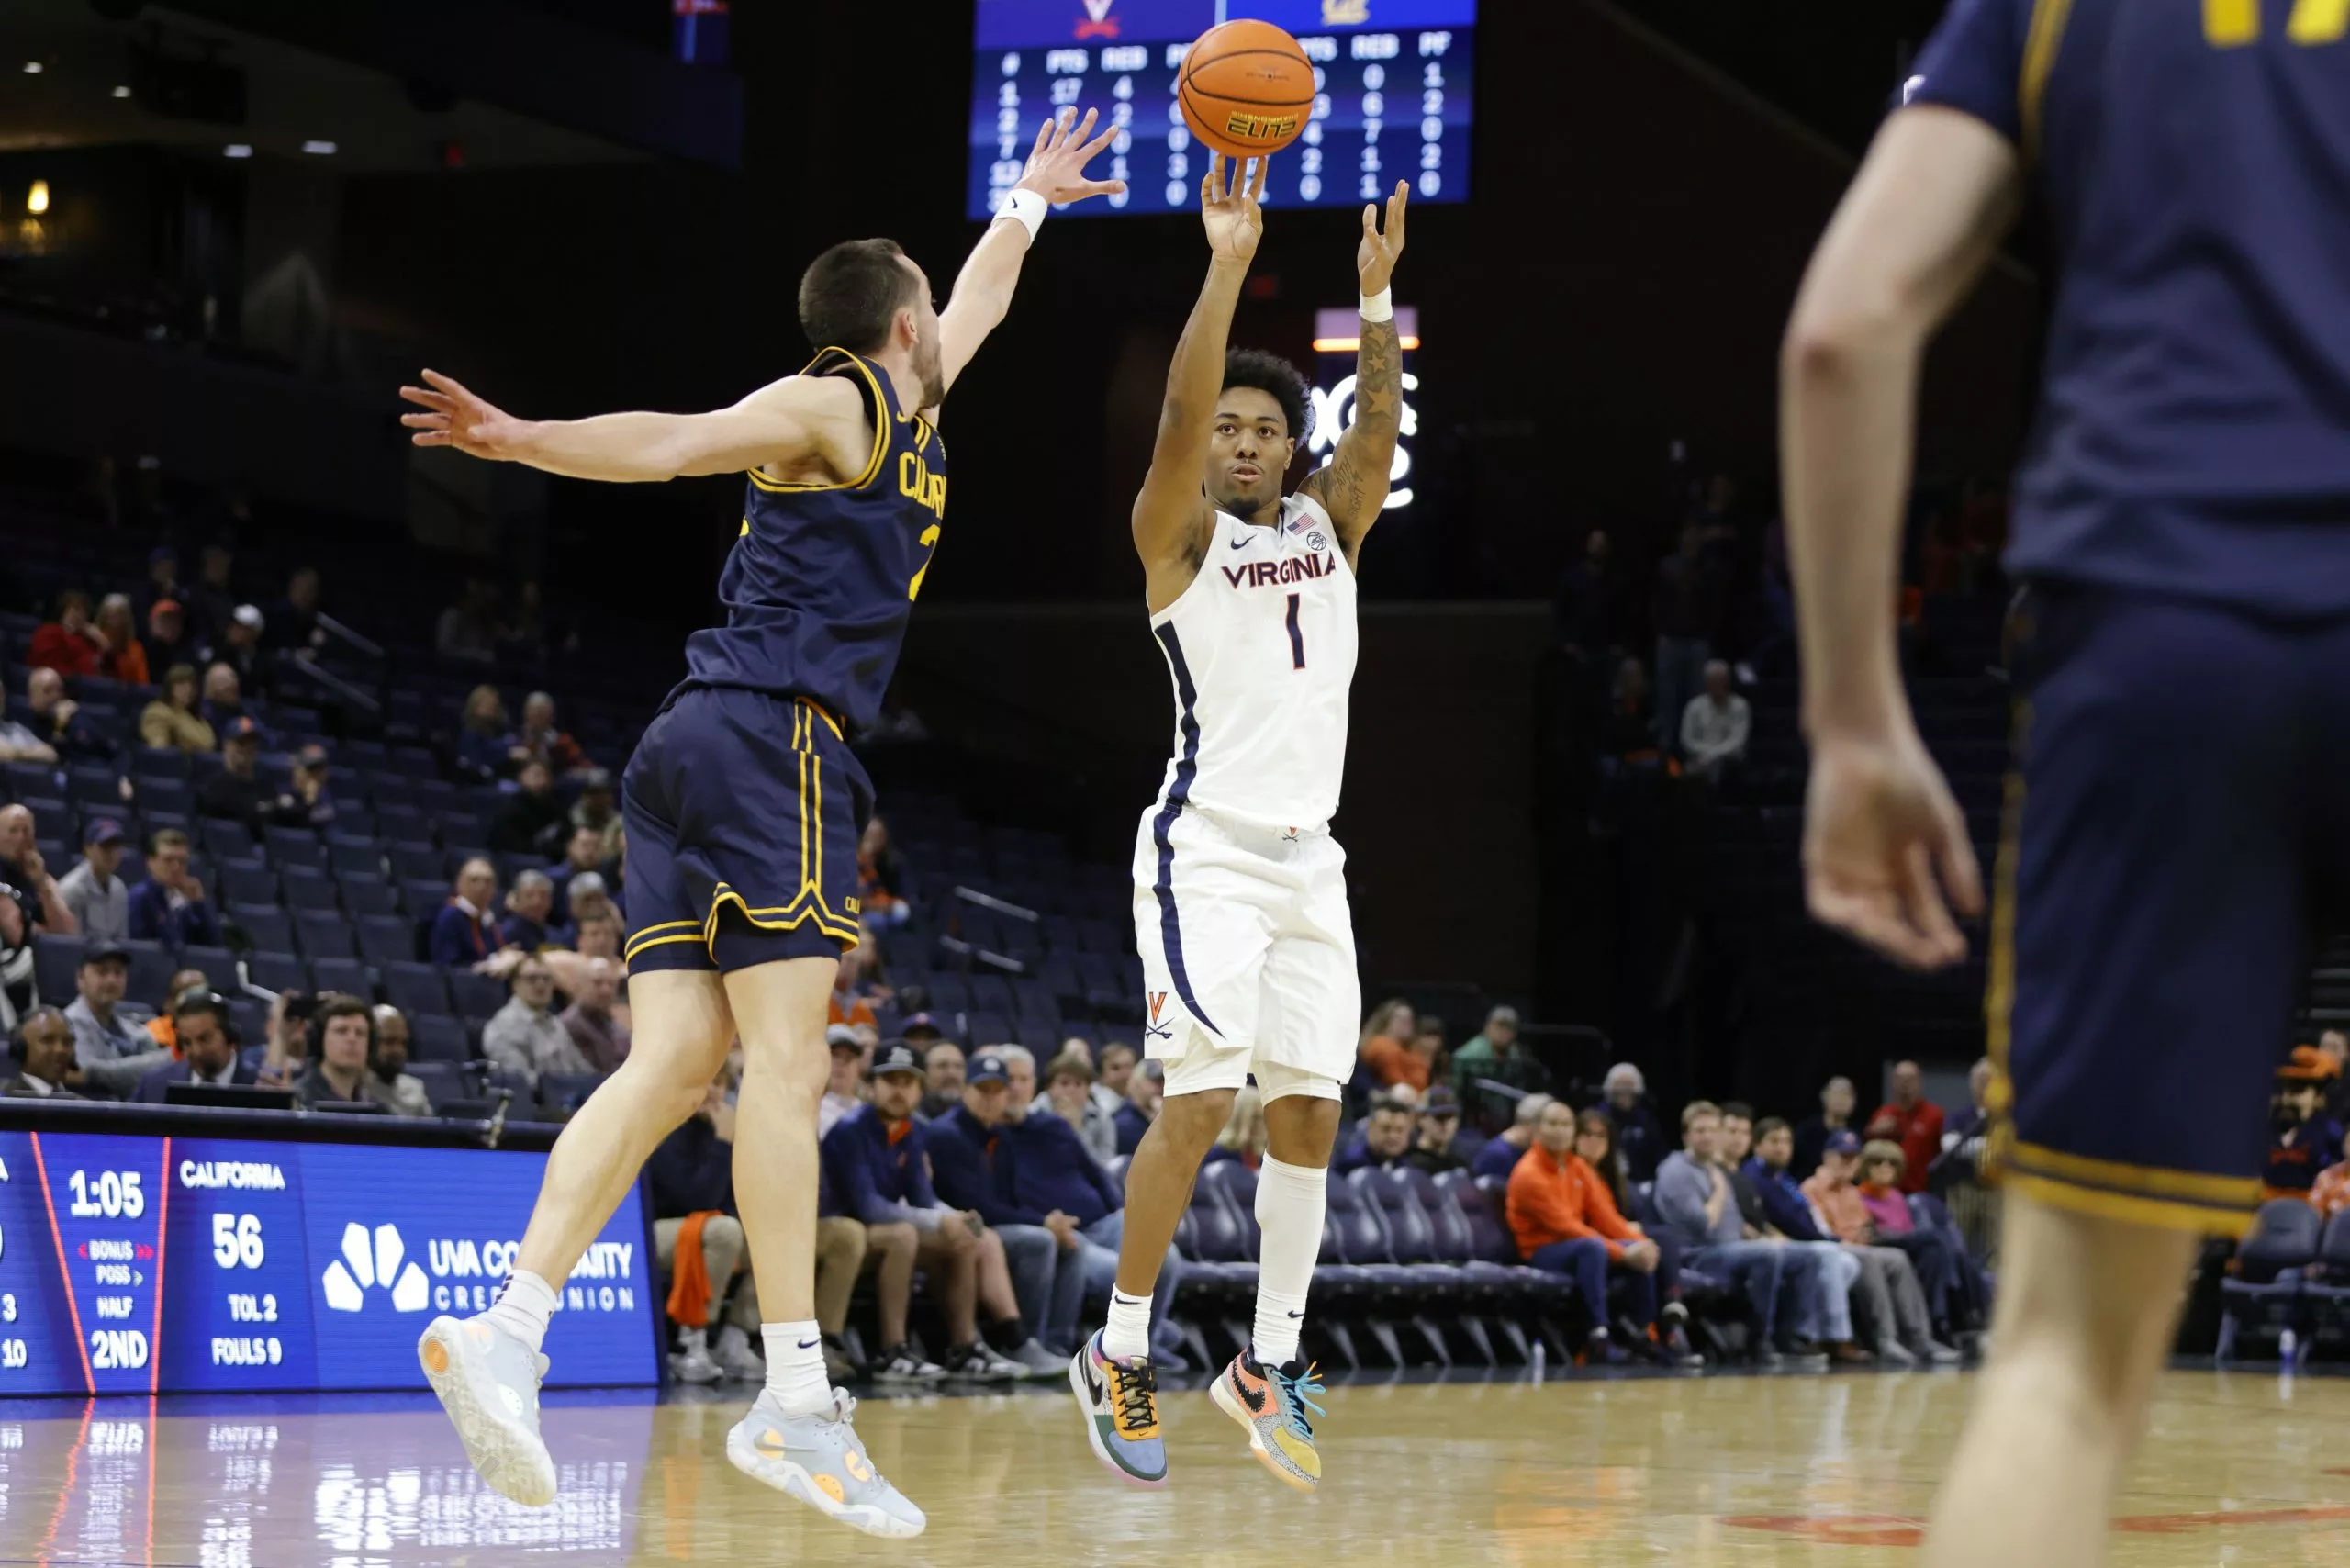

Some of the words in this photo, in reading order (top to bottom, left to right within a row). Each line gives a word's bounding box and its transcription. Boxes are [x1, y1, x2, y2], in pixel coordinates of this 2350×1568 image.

[1226, 117, 1297, 140] ELITE
[1221, 550, 1337, 589] VIRGINIA
[1286, 593, 1305, 670] 1
[180, 1159, 285, 1190] CALIFORNIA
[69, 1170, 144, 1218] 1:05
[89, 1240, 134, 1260] BONUS
[212, 1213, 264, 1269] 56
[428, 1239, 483, 1277] UVA
[483, 1240, 632, 1279] CONITY
[95, 1264, 131, 1285] POSS
[2, 1294, 17, 1322] 3
[96, 1296, 133, 1318] HALF
[228, 1294, 263, 1321] TOL
[263, 1294, 278, 1321] 2
[1, 1338, 28, 1368] 10
[91, 1330, 149, 1369] 2ND
[211, 1338, 267, 1365] FOULS
[267, 1338, 283, 1365] 9
